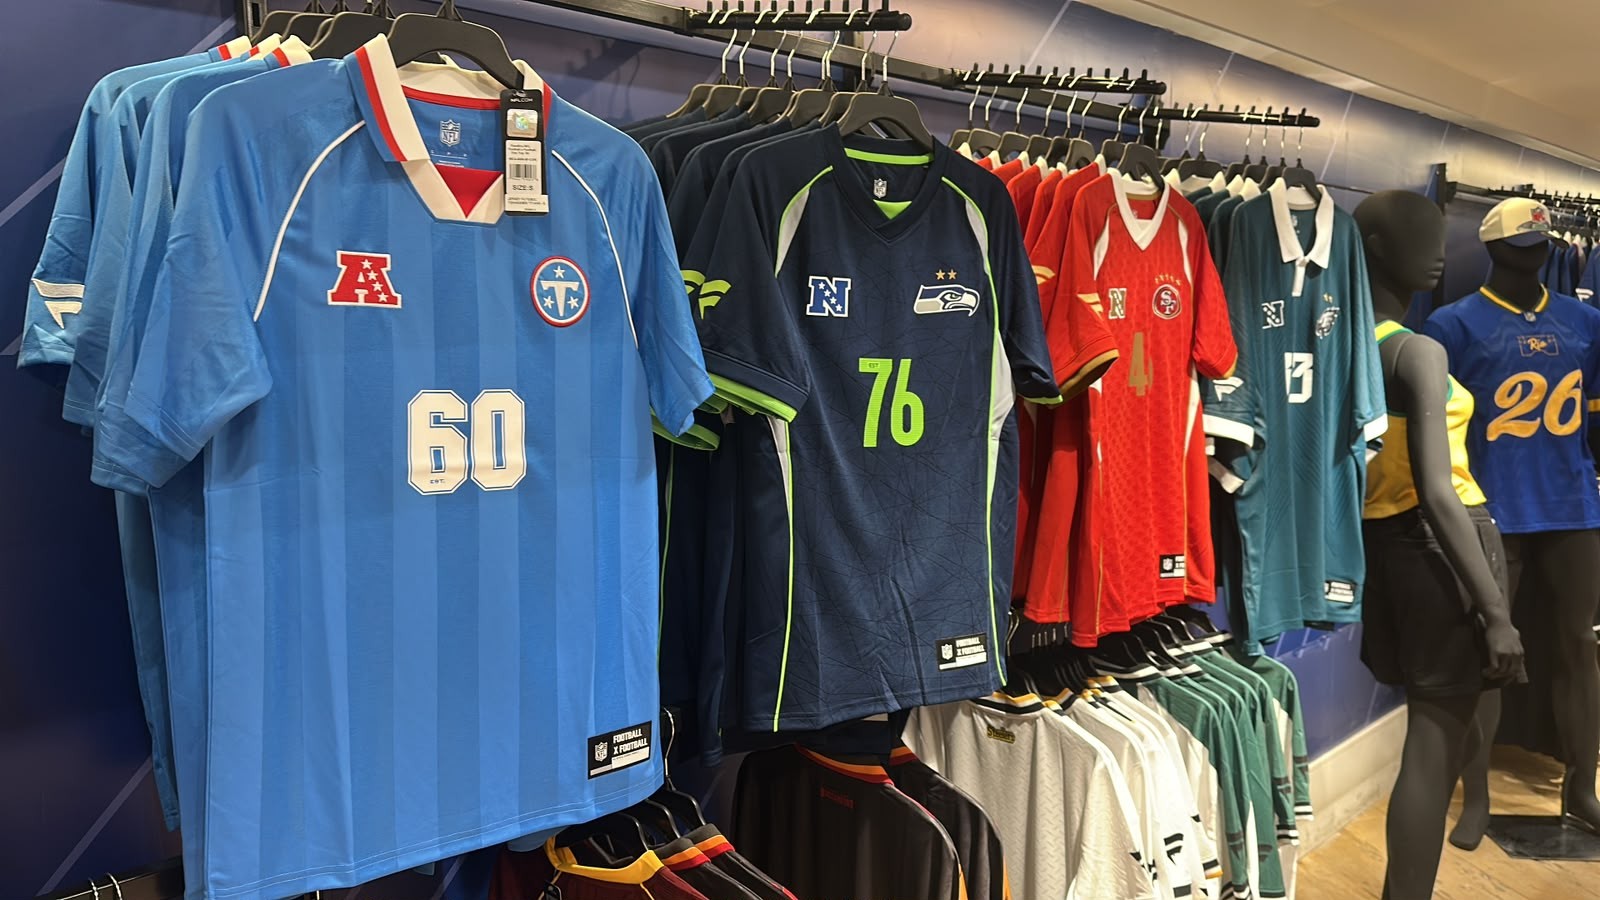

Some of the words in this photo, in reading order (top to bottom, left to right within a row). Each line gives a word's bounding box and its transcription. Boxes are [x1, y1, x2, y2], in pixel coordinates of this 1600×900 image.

[327, 250, 401, 309] A
[540, 280, 579, 317] T
[806, 275, 851, 318] N
[1108, 287, 1127, 320] N
[1261, 300, 1285, 330] N
[859, 357, 925, 448] 76
[1486, 368, 1583, 441] 26
[407, 389, 527, 495] 60
[612, 728, 642, 744] FOOTBALL
[613, 745, 619, 755] X
[619, 737, 648, 753] FOOTBALL
